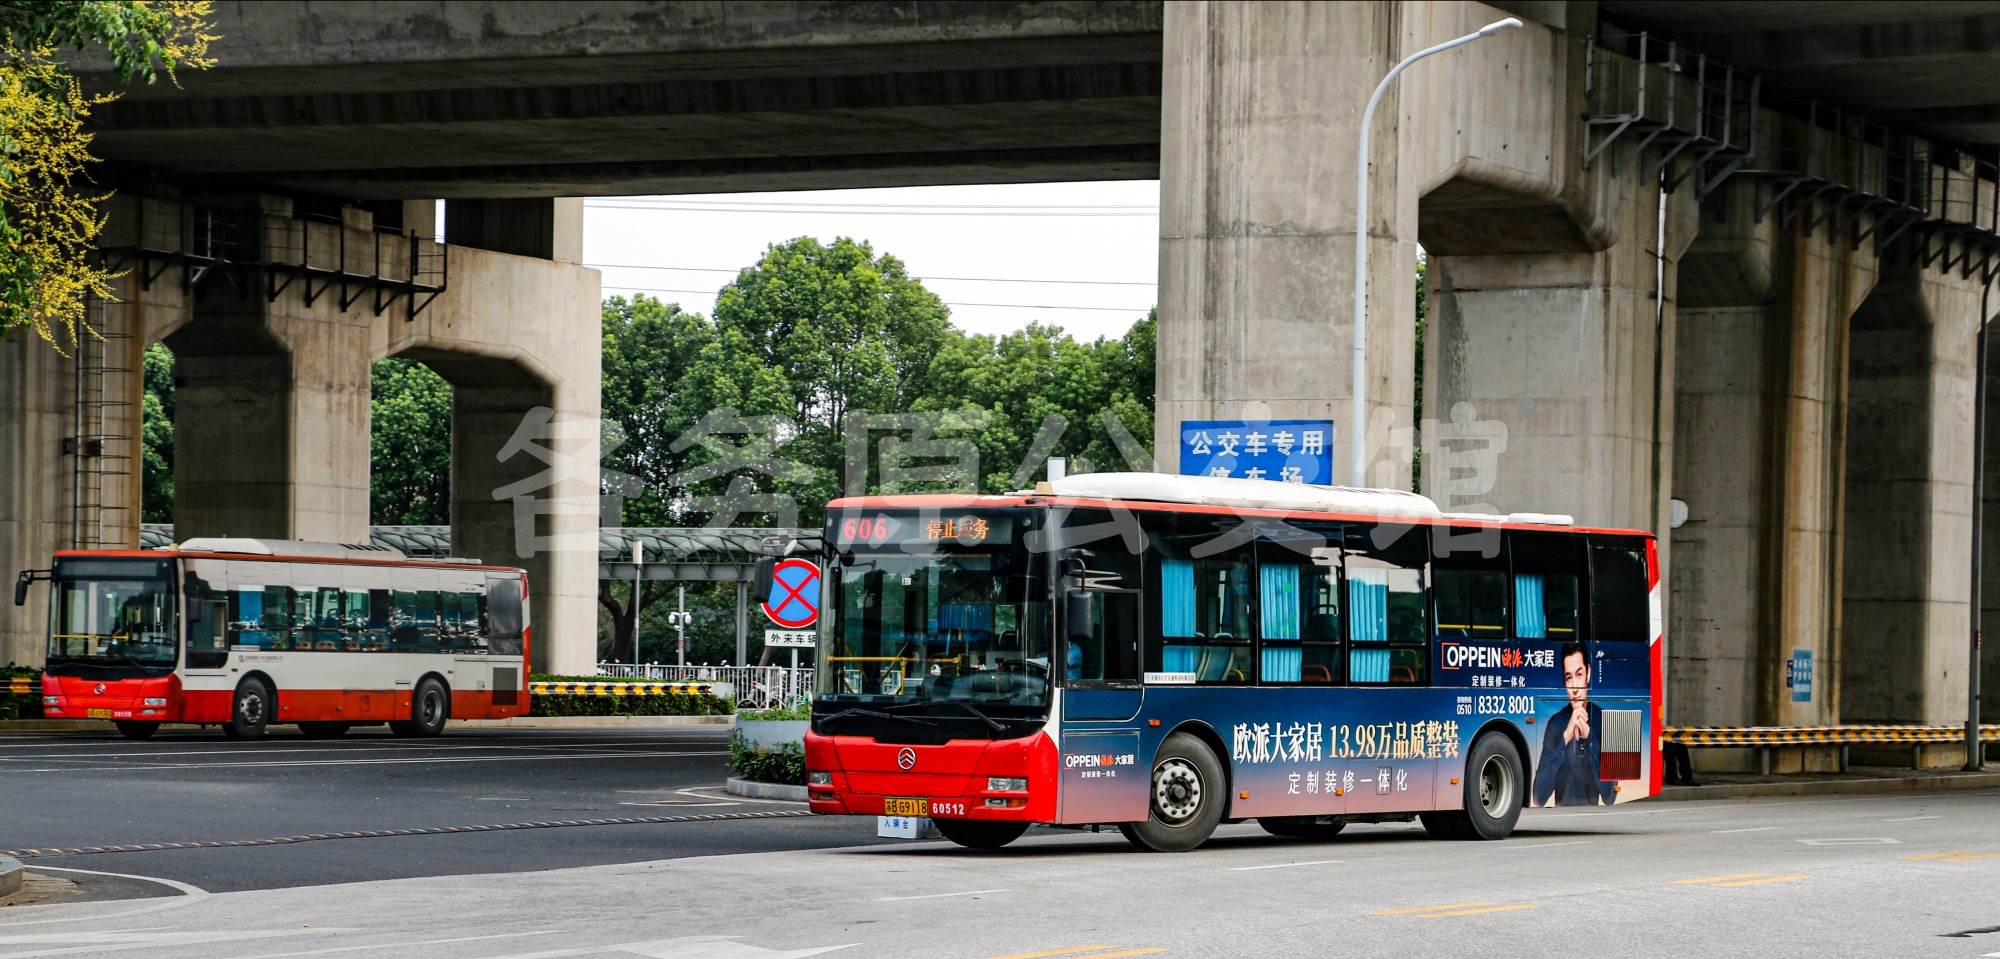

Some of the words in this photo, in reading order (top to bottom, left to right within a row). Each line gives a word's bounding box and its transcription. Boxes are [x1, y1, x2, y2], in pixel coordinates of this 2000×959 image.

[1189, 430, 1324, 457] 公交车专用
[843, 517, 887, 541] 606
[1446, 645, 1501, 668] OPPEIN
[1471, 674, 1526, 688] 定制装修一体化
[1456, 704, 1472, 715] 0510
[1478, 695, 1506, 714] 8332
[1508, 695, 1536, 714] 8001
[1232, 721, 1324, 764] 欧派大家居
[1329, 720, 1460, 760] 13.98万品质整装
[1065, 754, 1101, 768] OPPEIN
[1288, 769, 1409, 796] 定制装修一体化
[932, 802, 965, 815] 60512
